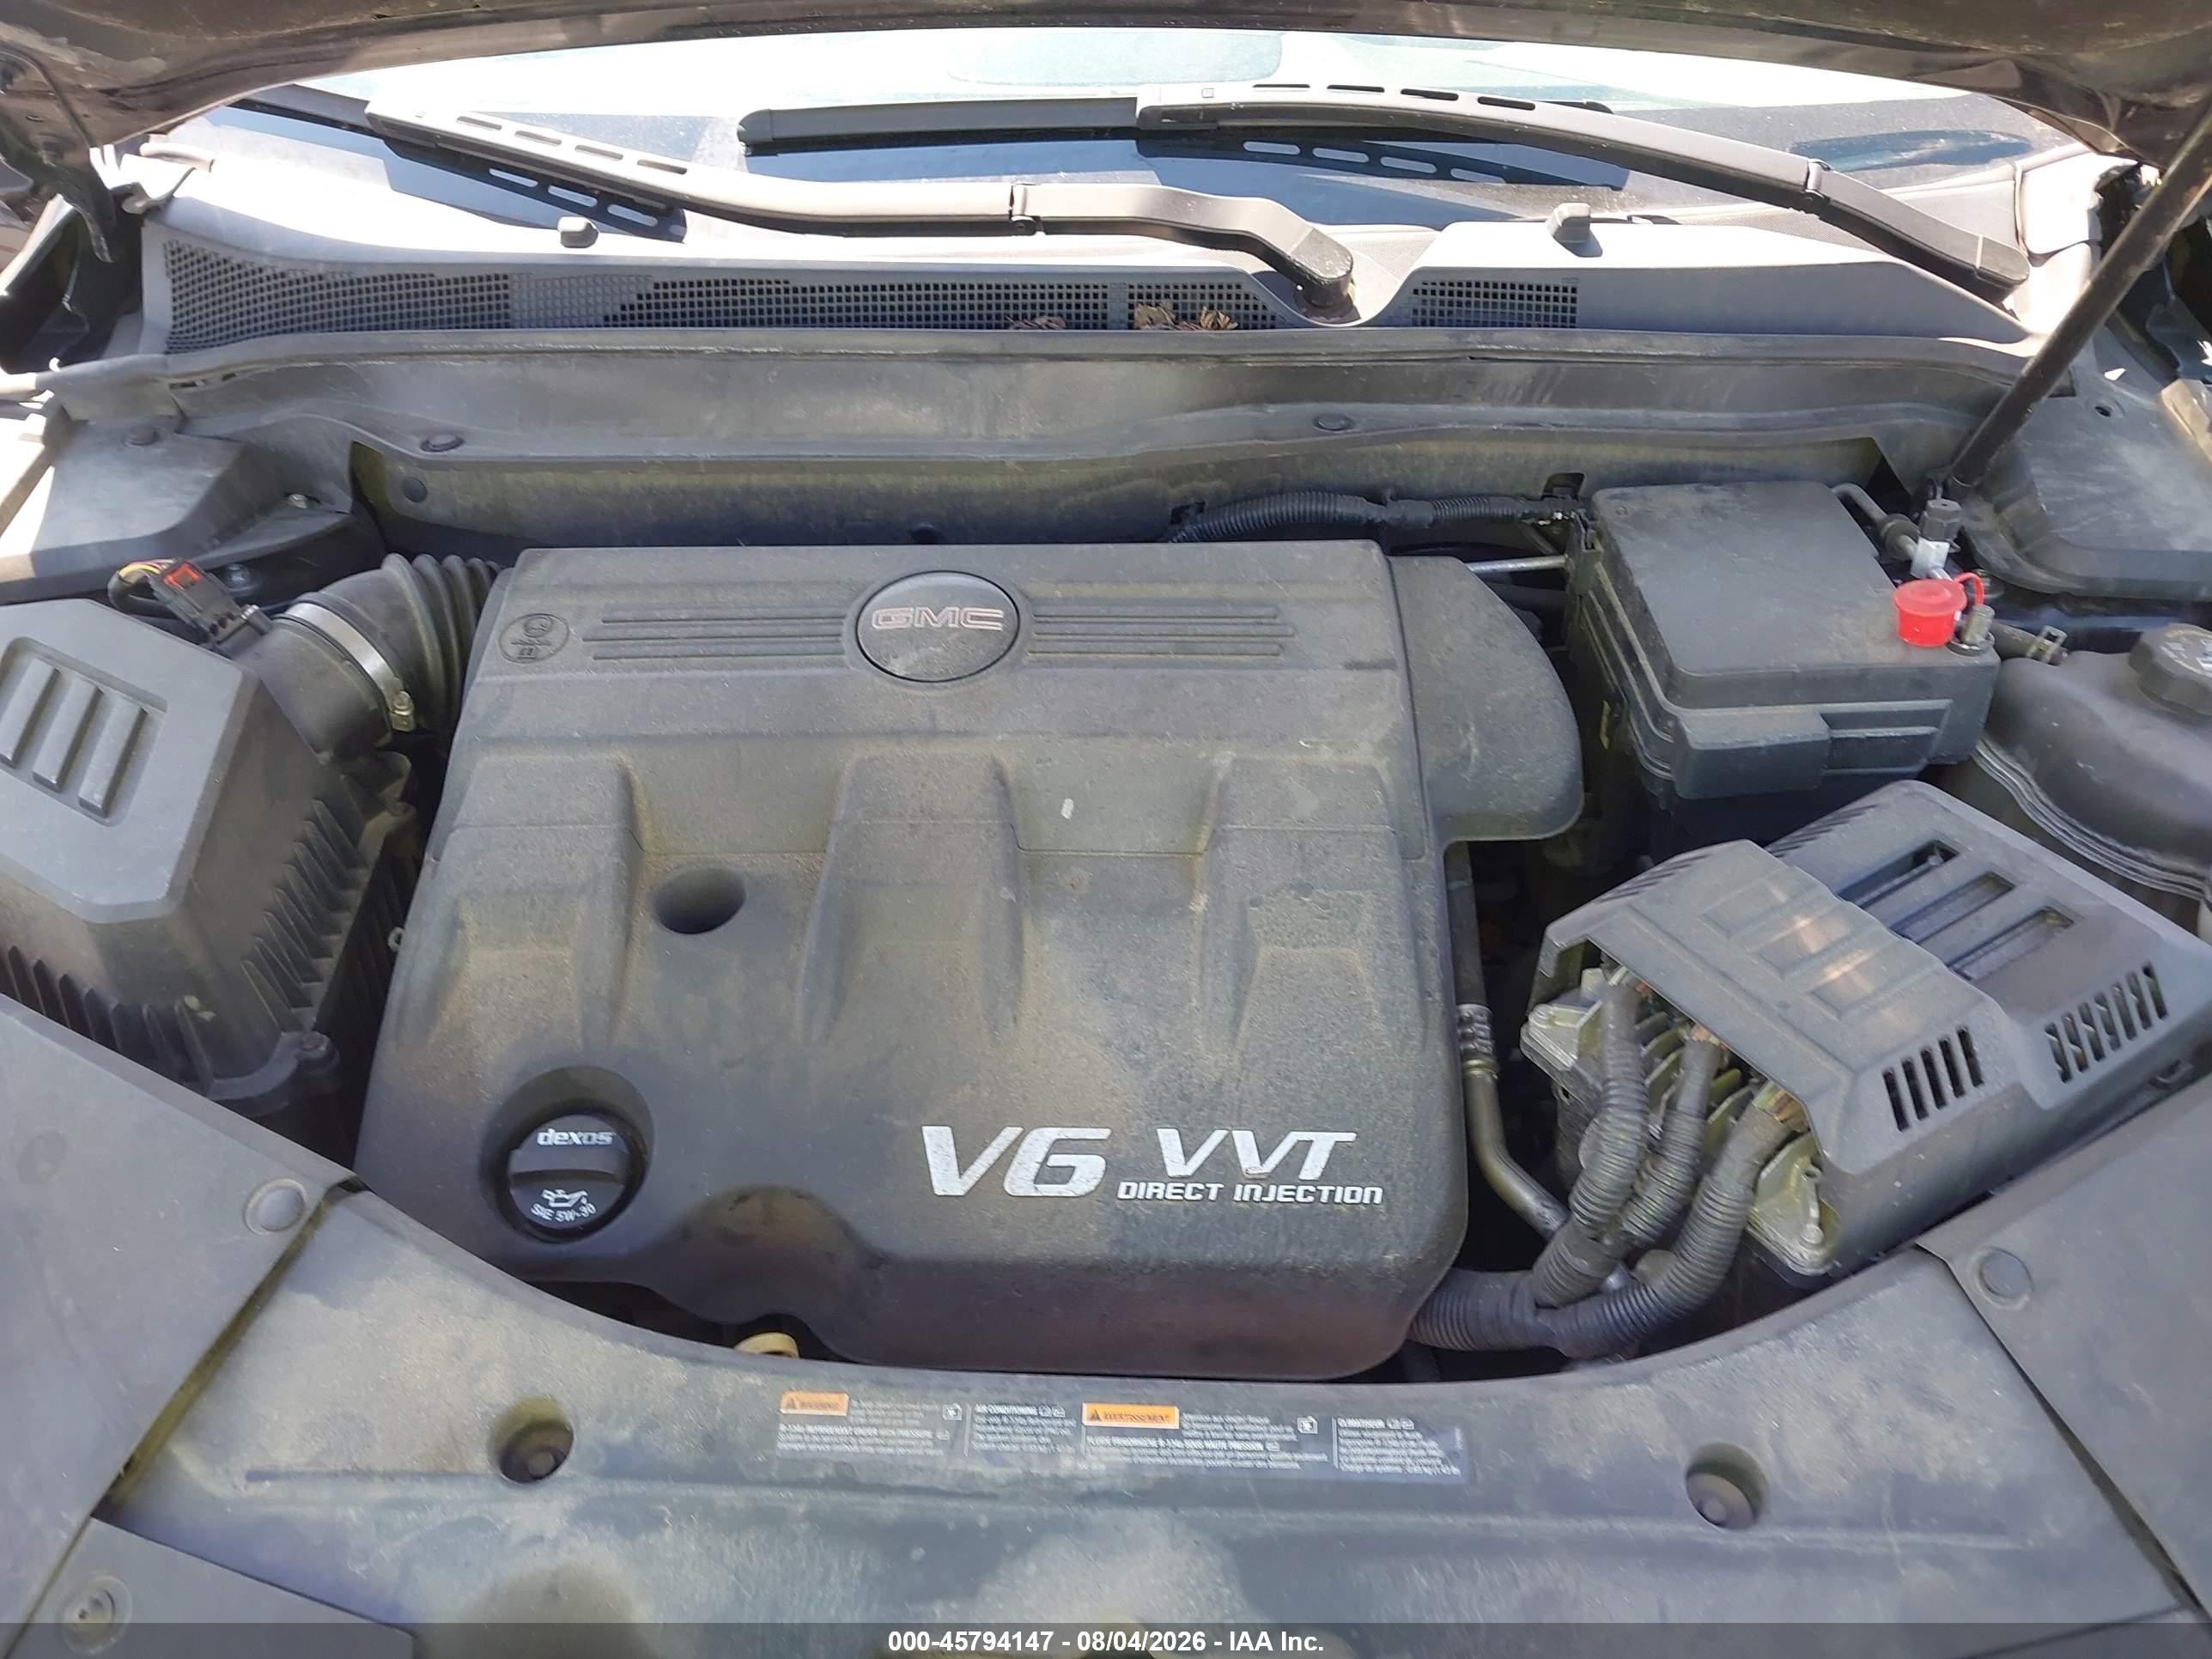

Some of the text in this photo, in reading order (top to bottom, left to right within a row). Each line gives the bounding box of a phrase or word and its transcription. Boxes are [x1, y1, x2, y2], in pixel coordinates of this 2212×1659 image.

[871, 605, 1005, 632] GMC
[537, 1128, 614, 1146] dexos
[921, 1125, 1358, 1197] V6 VVT
[1116, 1181, 1384, 1205] DIRECT INJECTION
[556, 1202, 597, 1223] 5W-30
